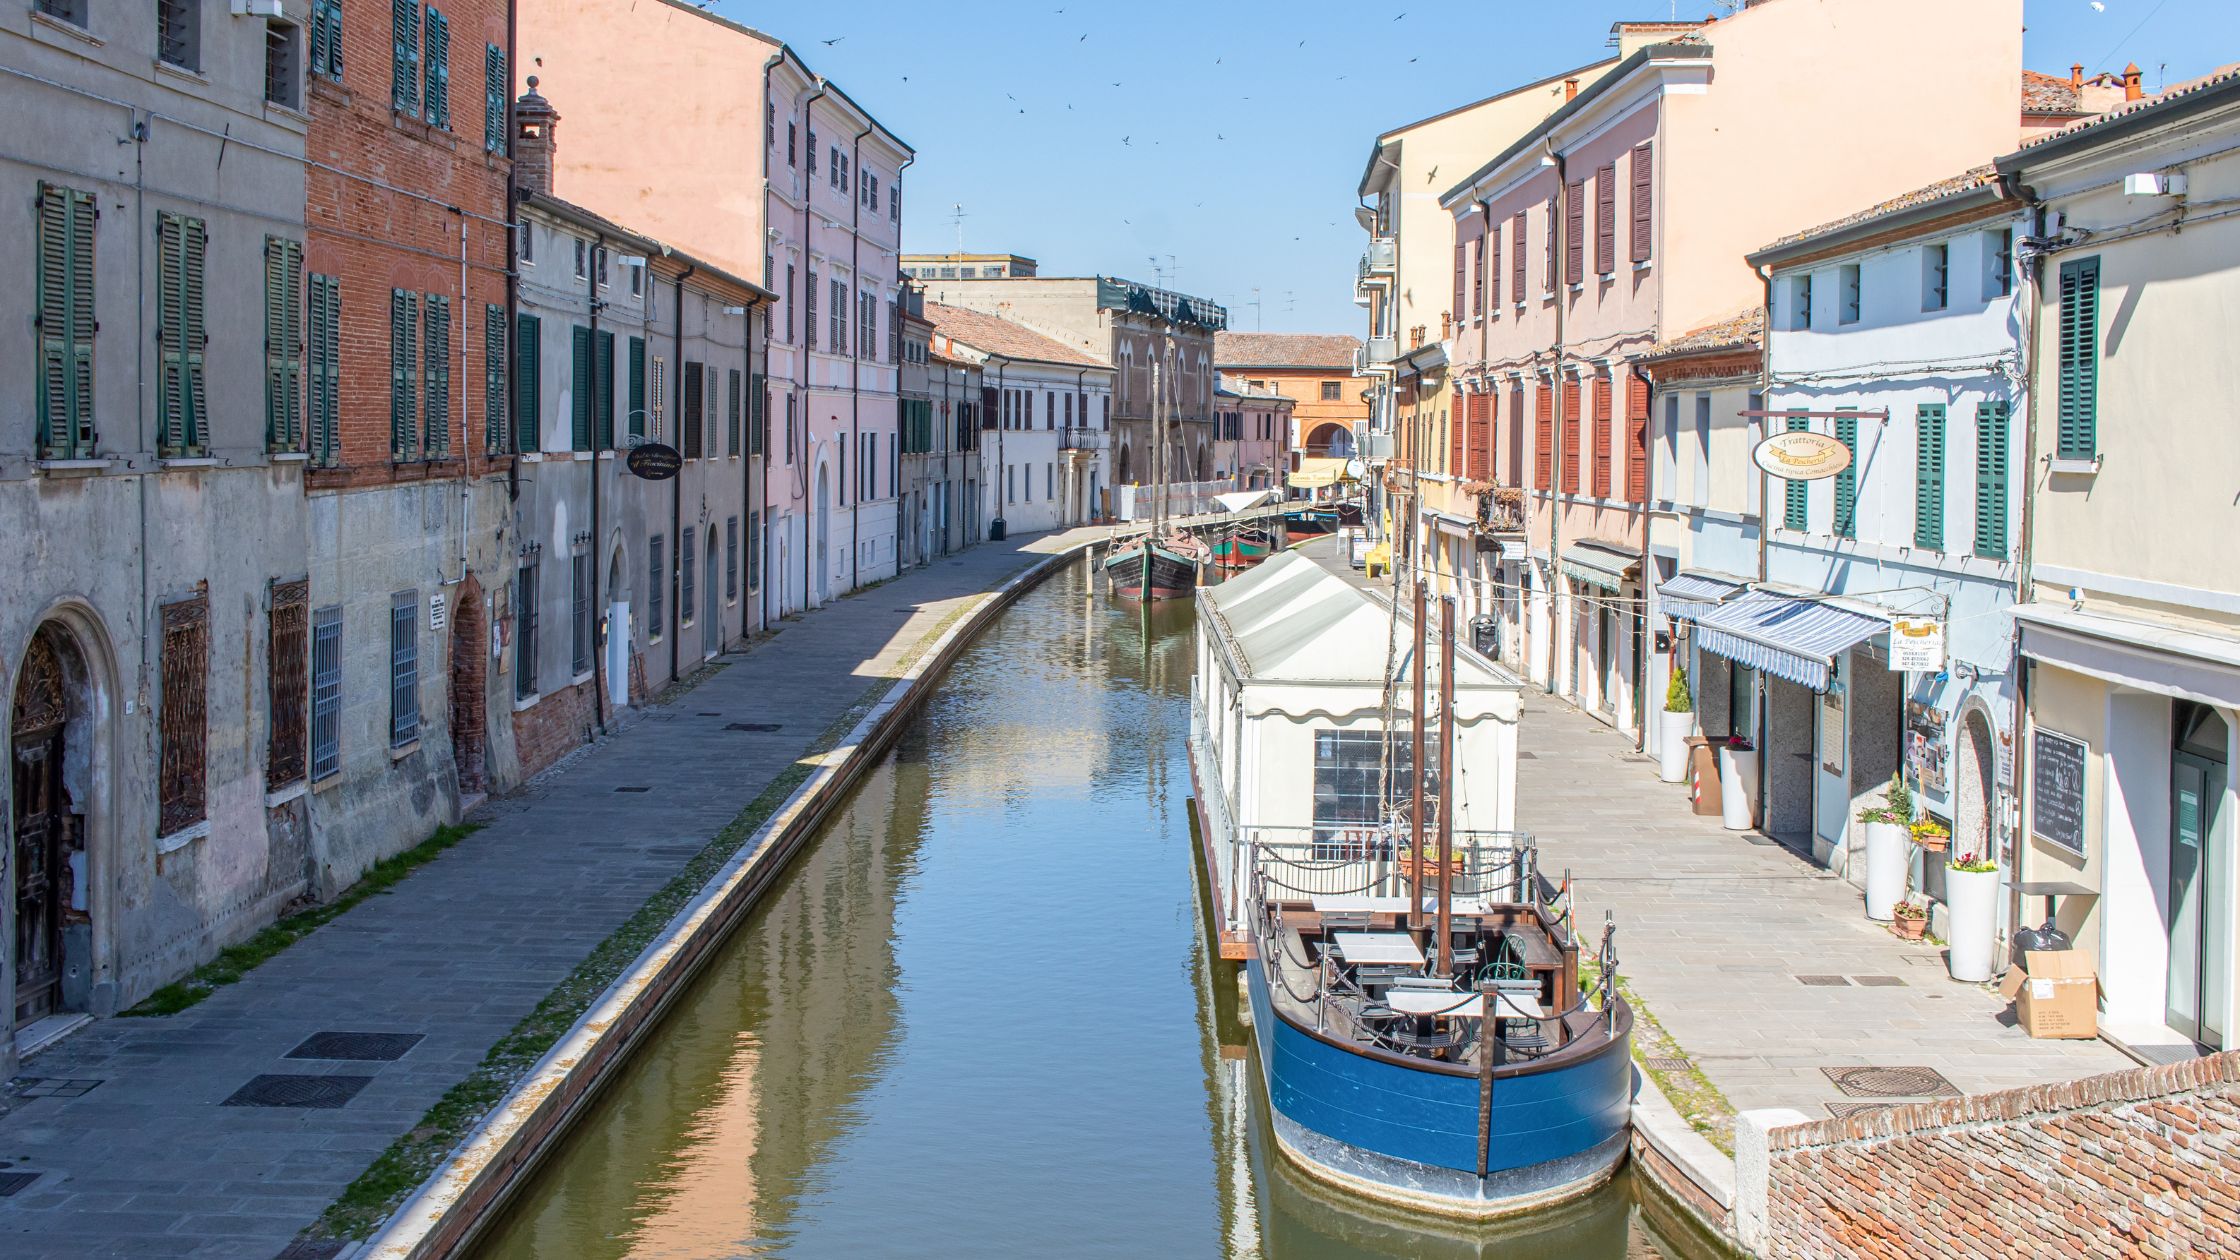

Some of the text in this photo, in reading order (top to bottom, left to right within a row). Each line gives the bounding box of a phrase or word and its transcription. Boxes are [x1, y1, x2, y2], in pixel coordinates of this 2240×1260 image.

[1780, 436, 1825, 448] Trattoria
[1794, 457, 1824, 465] Pescheria
[1762, 460, 1784, 472] Cucina
[1785, 468, 1804, 476] tipica
